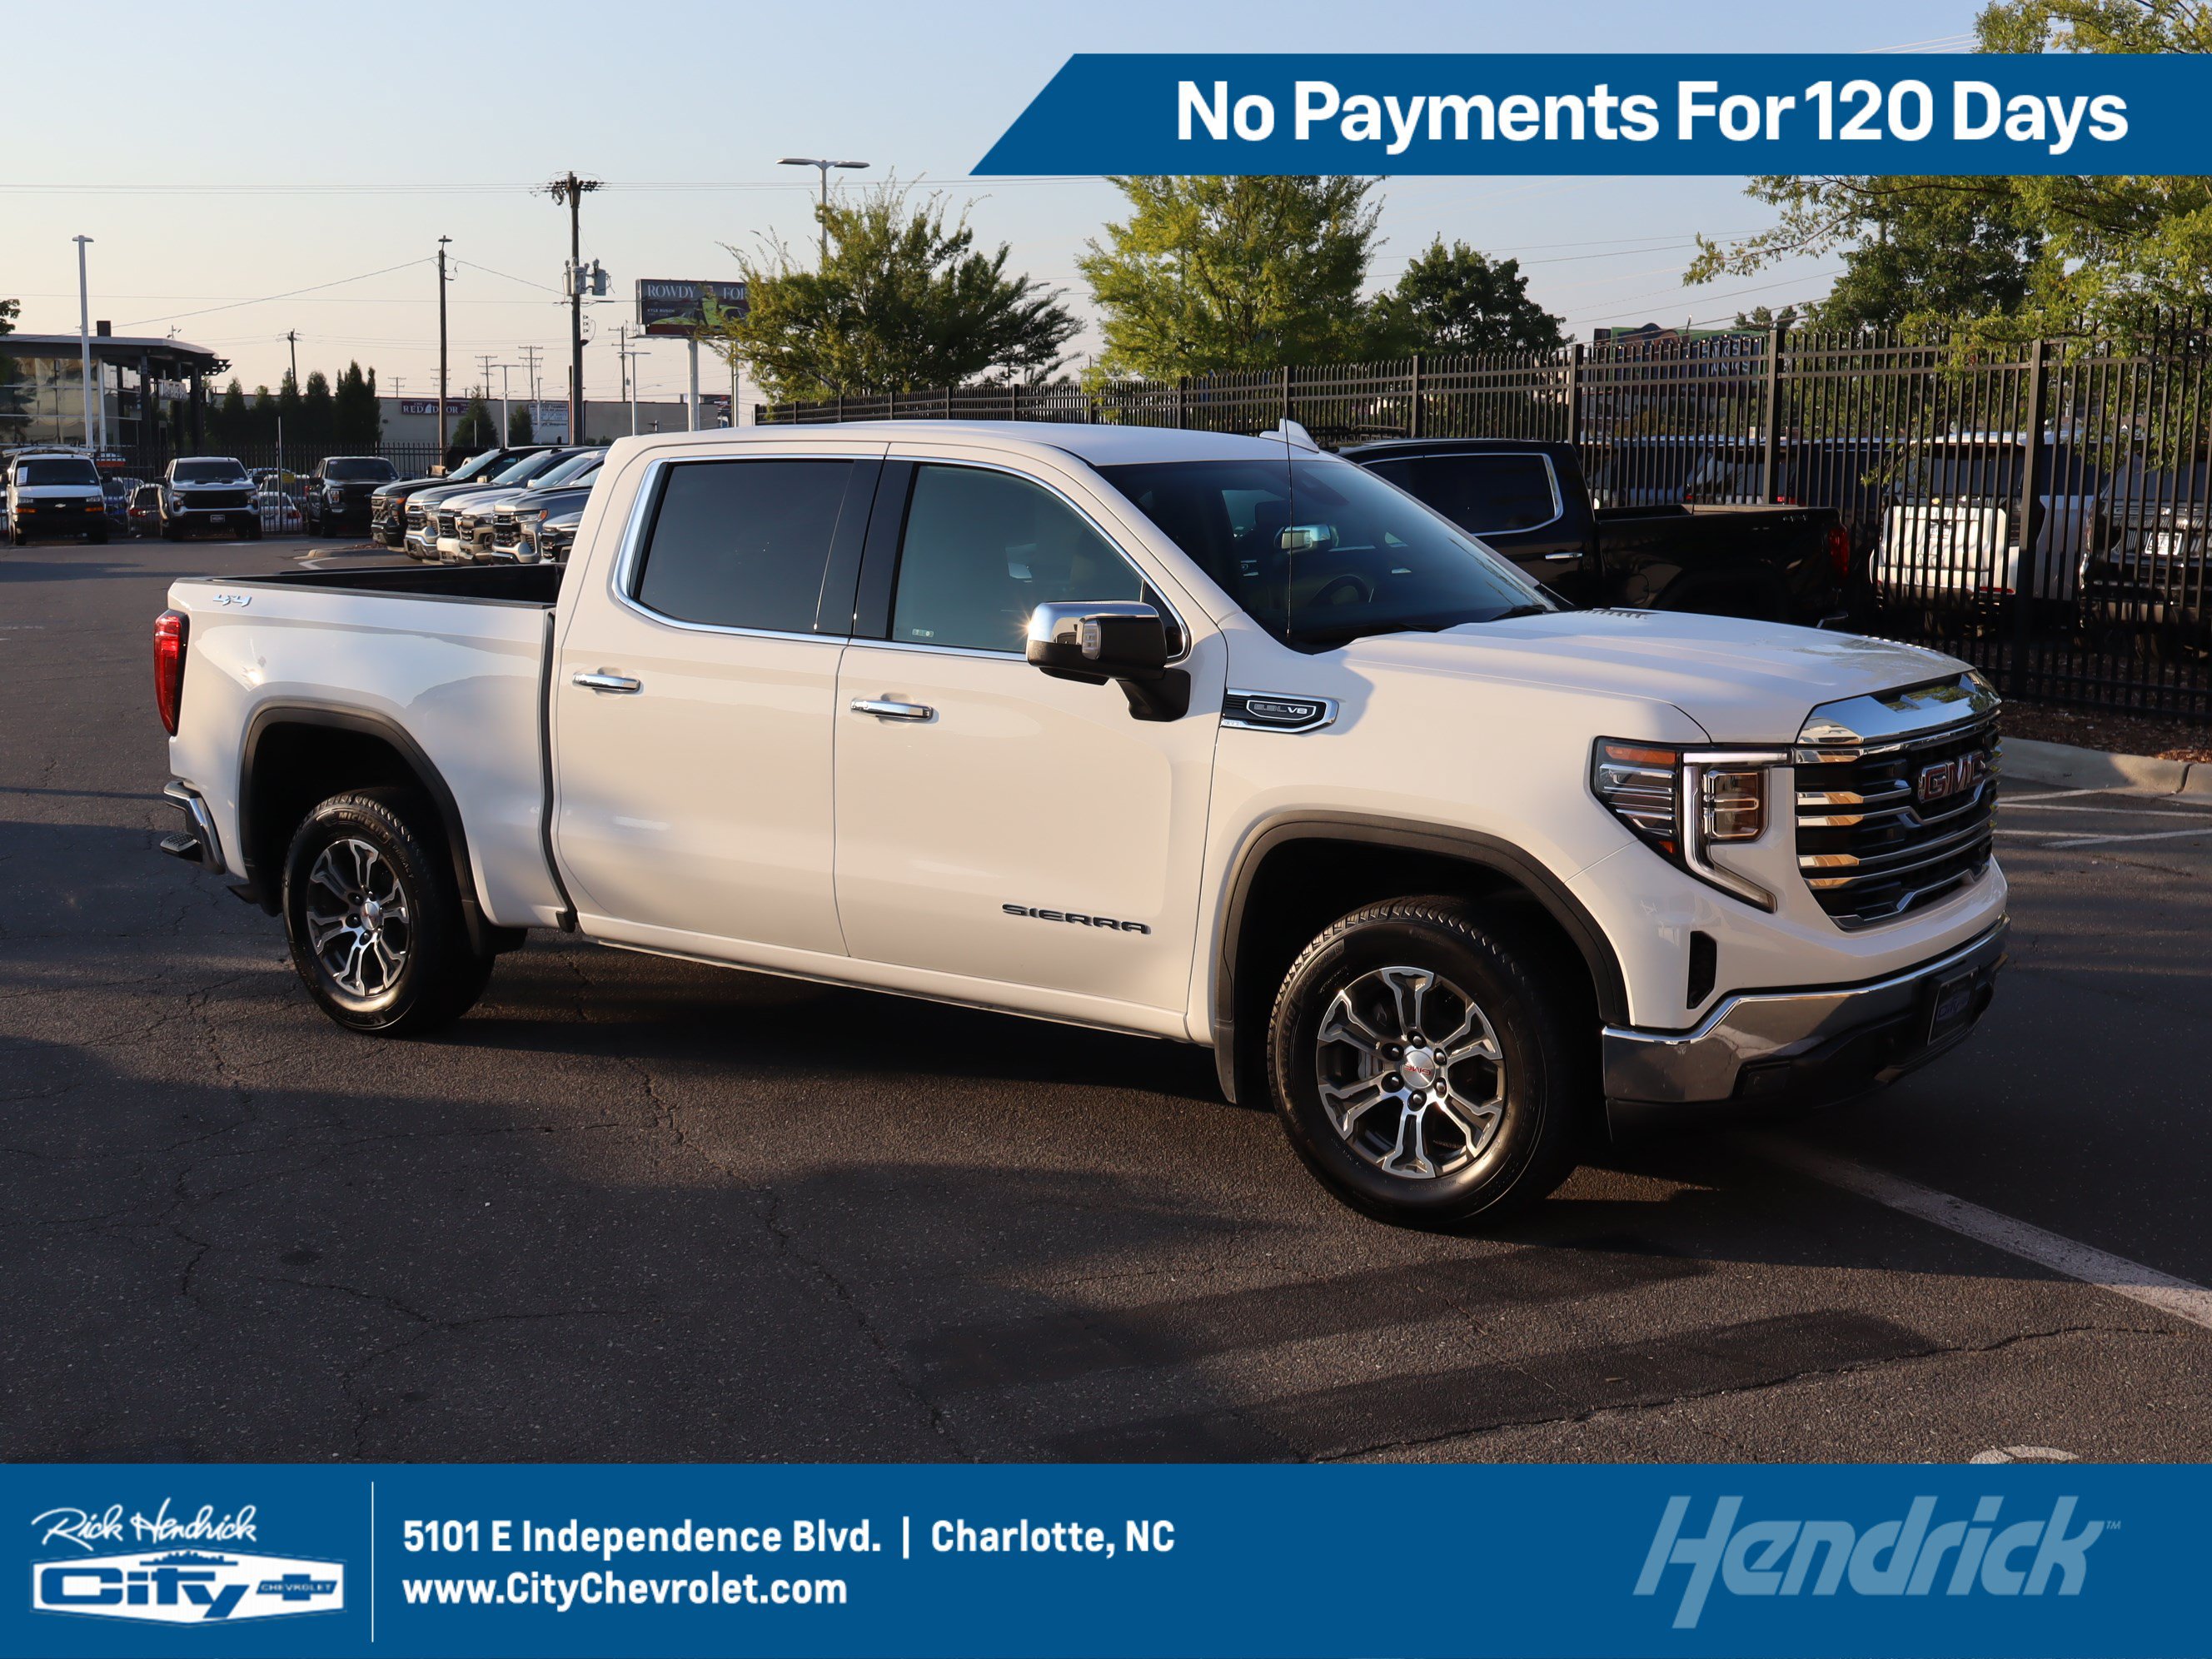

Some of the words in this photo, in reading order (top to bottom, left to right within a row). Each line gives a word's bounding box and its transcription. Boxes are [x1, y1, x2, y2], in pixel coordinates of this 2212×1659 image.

[647, 284, 696, 299] ROWDY
[402, 405, 424, 414] RED
[432, 406, 458, 414] DOR
[1919, 750, 1985, 804] GMC
[1002, 904, 1151, 934] SIERRA
[1403, 1063, 1432, 1076] GMC
